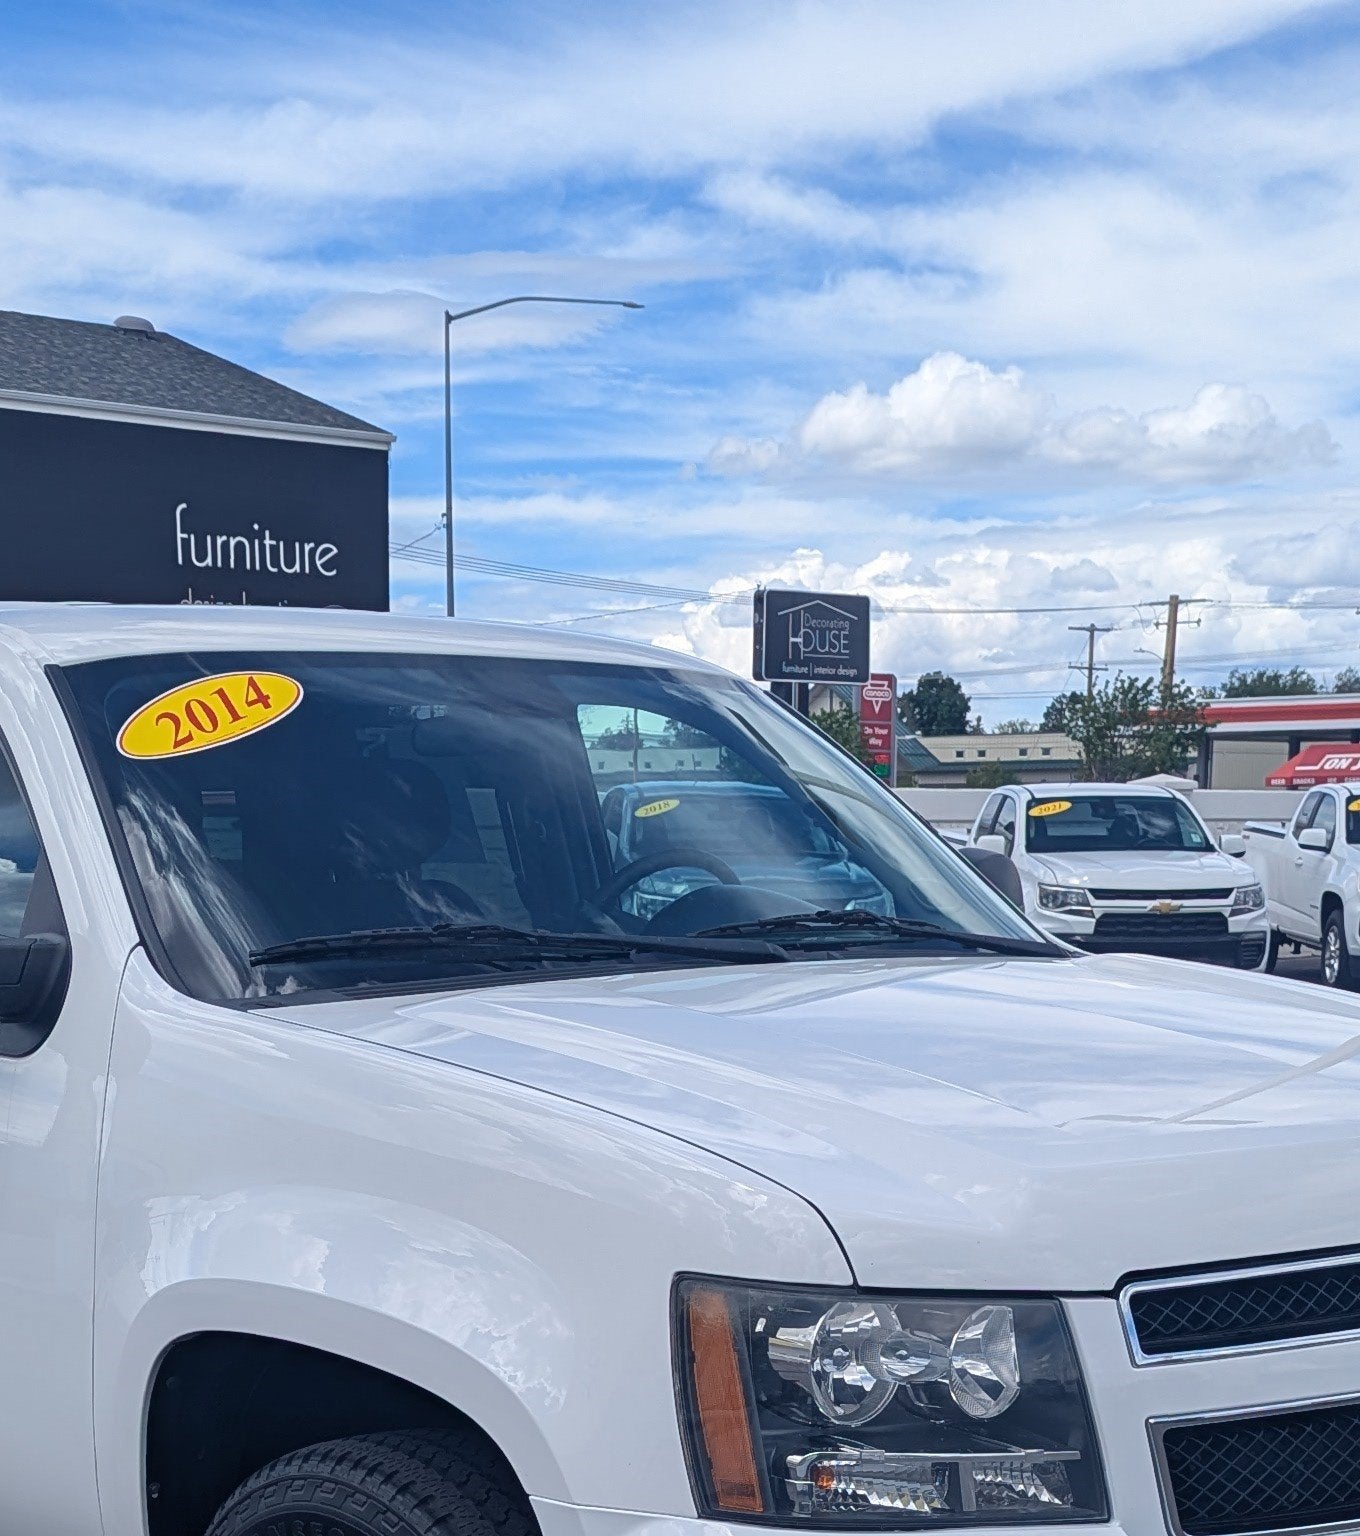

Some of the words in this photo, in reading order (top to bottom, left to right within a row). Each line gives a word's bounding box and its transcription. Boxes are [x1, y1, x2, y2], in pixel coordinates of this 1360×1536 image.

[175, 502, 339, 577] furniture
[804, 613, 850, 631] Decorating
[782, 661, 809, 674] furniture
[813, 664, 836, 676] interior
[836, 664, 858, 678] design
[155, 675, 272, 750] 2014
